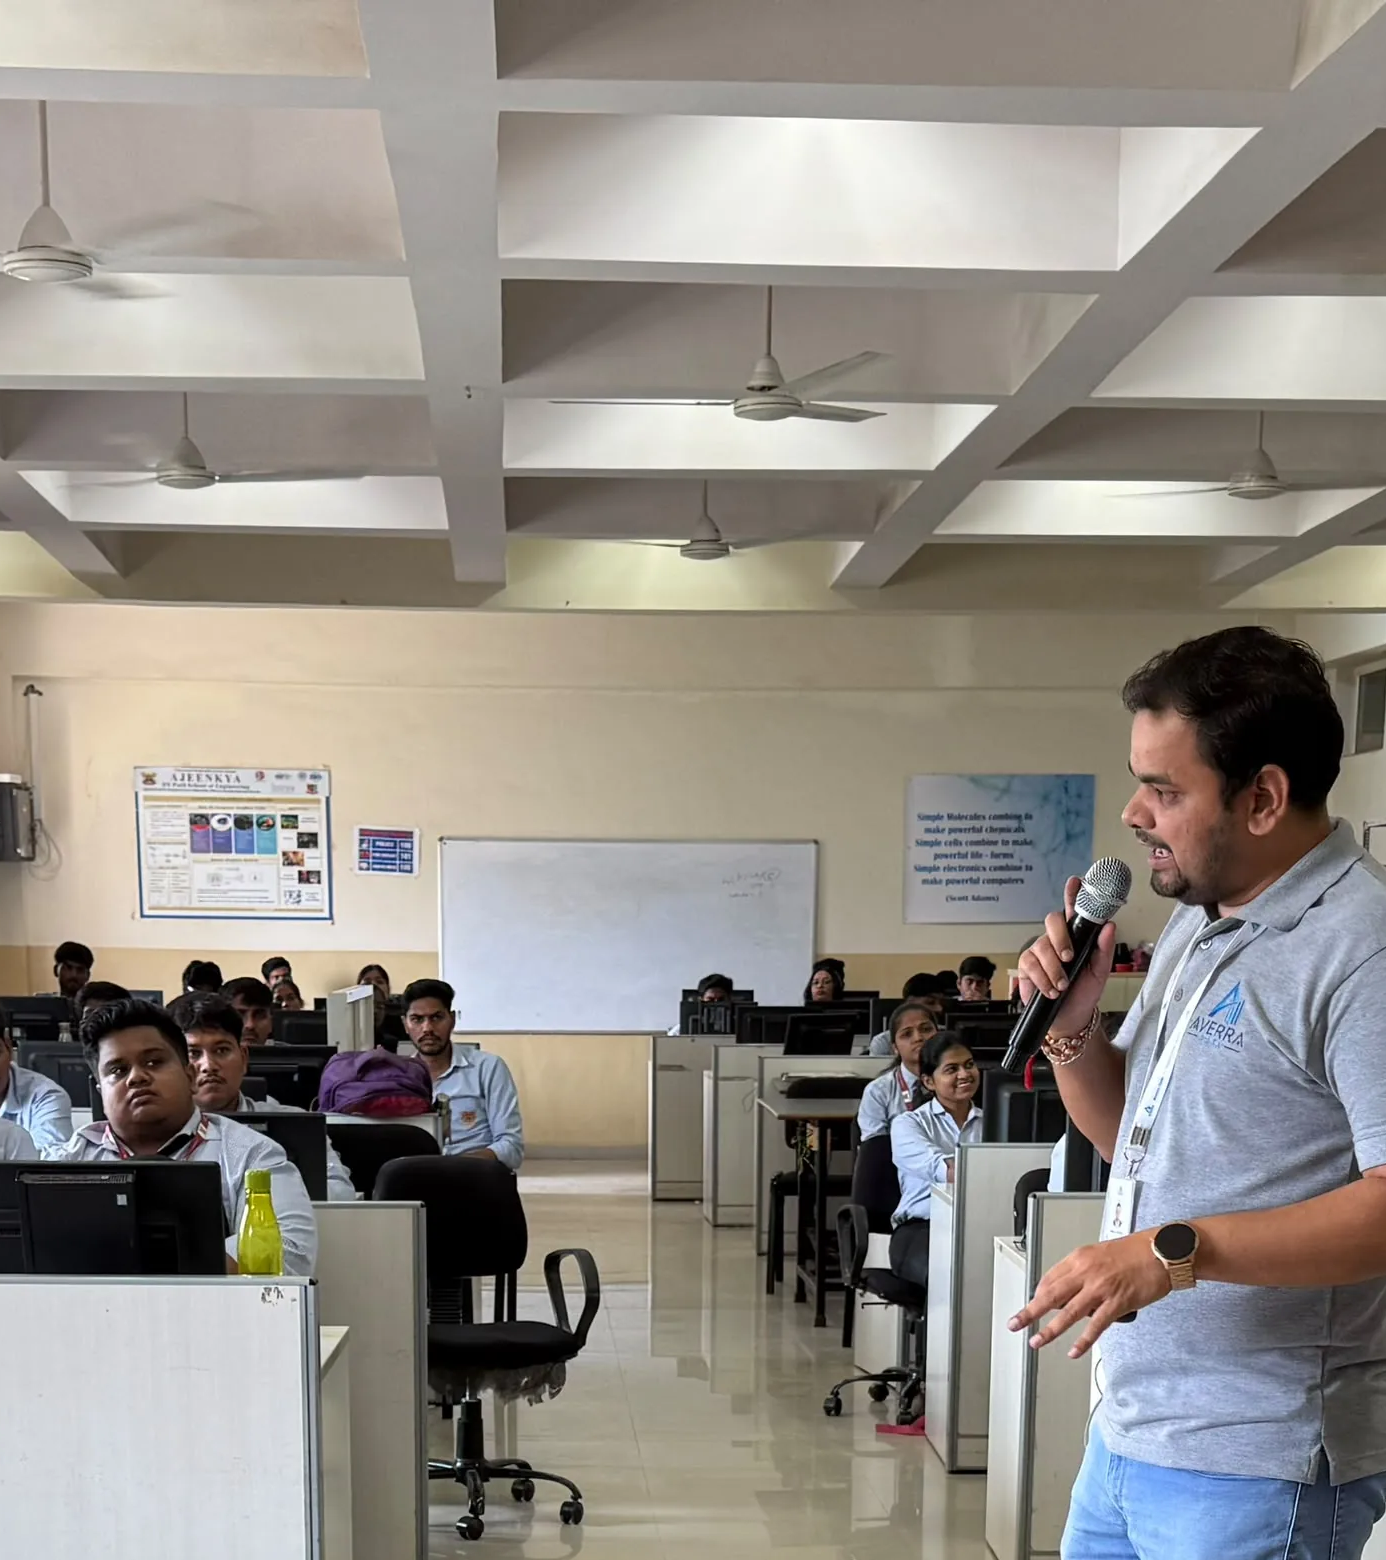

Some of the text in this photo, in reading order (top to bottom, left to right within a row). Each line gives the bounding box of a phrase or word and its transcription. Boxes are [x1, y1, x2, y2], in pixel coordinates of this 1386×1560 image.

[170, 772, 242, 784] AJEENKYA
[917, 812, 1033, 822] Simple Molecules combine to
[924, 825, 1025, 835] make powerful chemicals
[915, 838, 1033, 848] Simple cells combine to make
[933, 851, 968, 861] powerful
[970, 851, 983, 859] life
[990, 851, 1014, 859] forms
[914, 864, 1033, 874] Simple electronics combine to
[921, 876, 1025, 886] make powerful computers
[1189, 1016, 1244, 1048] AVERRA
